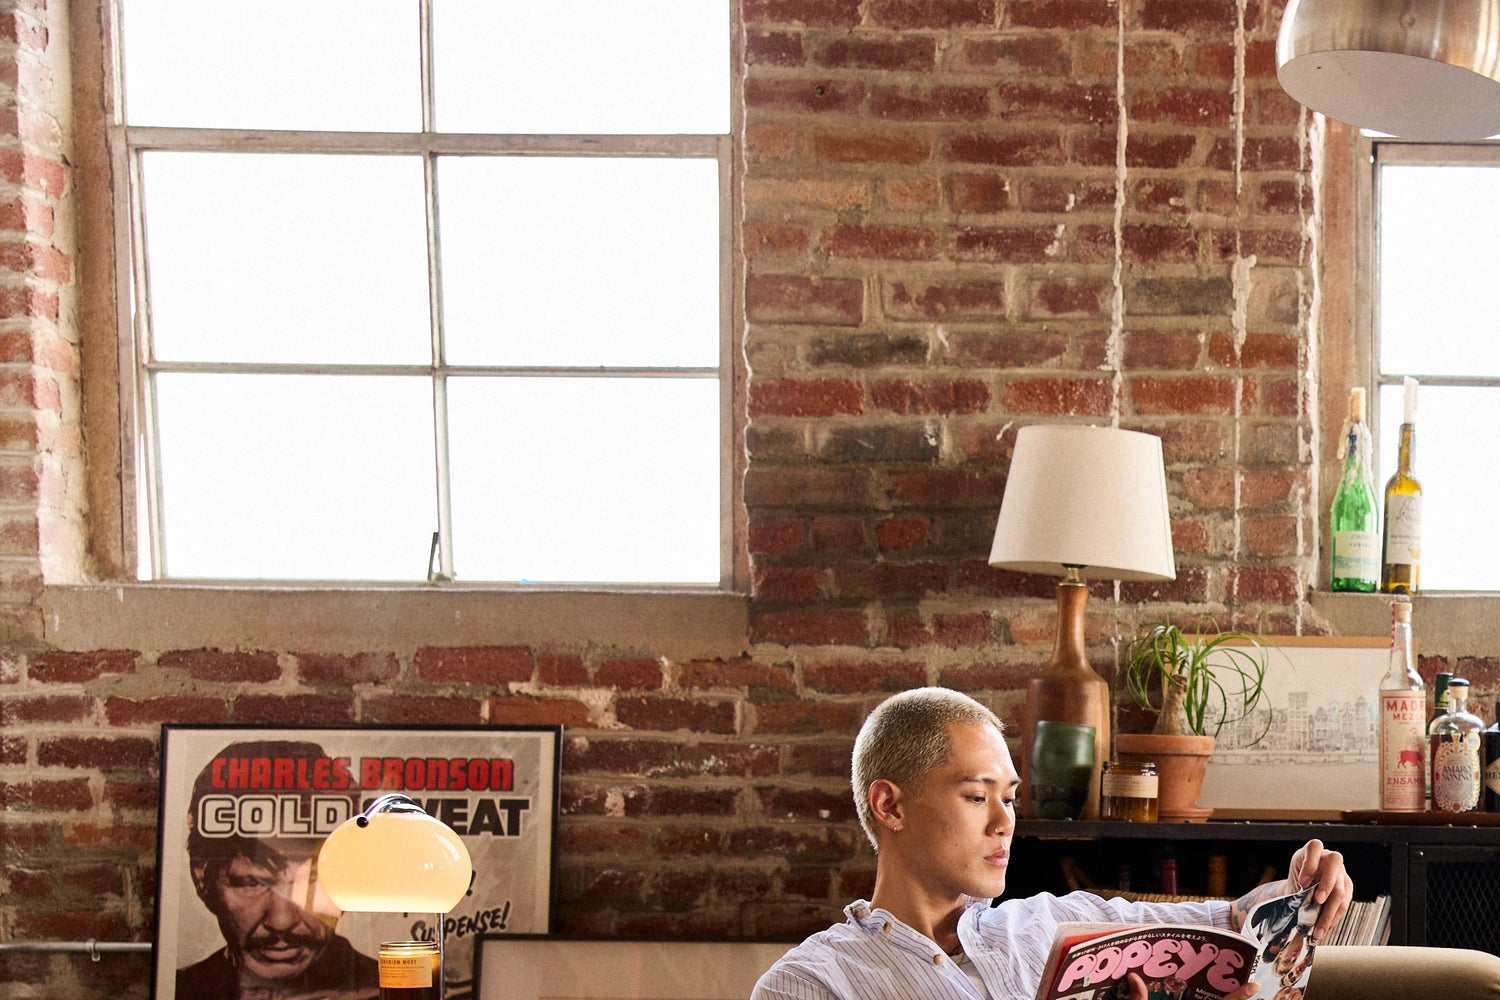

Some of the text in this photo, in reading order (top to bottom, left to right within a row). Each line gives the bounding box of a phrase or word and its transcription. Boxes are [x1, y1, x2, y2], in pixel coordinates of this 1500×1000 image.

[210, 756, 514, 791] CHARLES BRONSON
[200, 795, 351, 838] COLD
[1057, 938, 1245, 993] POPEYE
